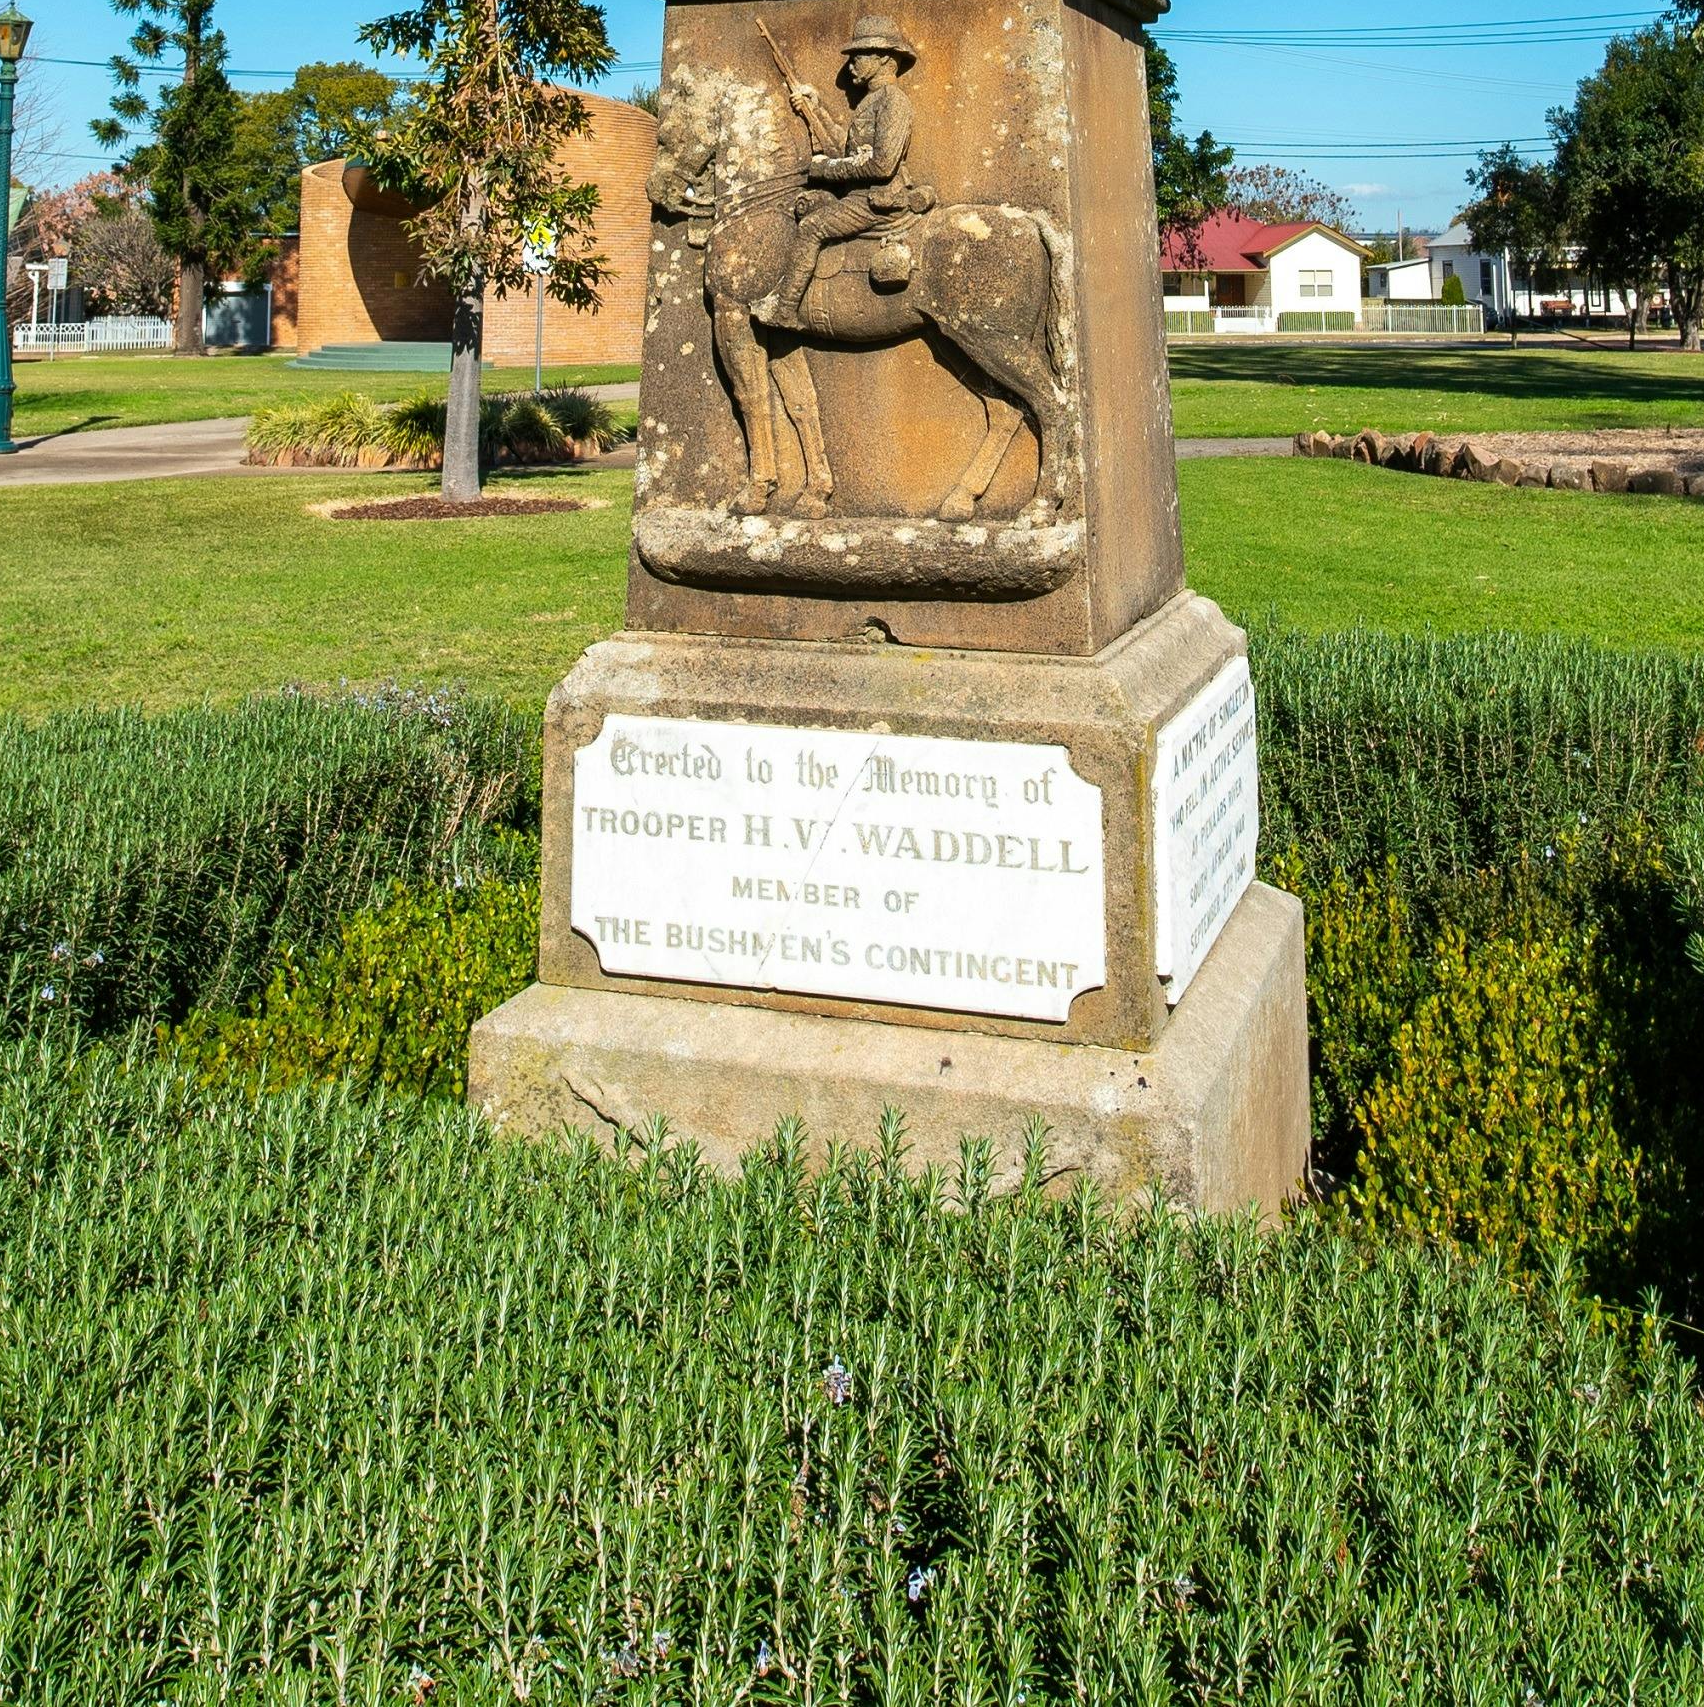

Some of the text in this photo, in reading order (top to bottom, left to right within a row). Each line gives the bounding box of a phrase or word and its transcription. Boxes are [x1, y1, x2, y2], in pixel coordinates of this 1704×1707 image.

[610, 730, 1057, 808] Erected to the Memory of
[1174, 754, 1180, 781] A
[1182, 723, 1207, 772] NATIVE
[1209, 712, 1217, 740] OF
[1186, 788, 1199, 820] FELL
[1200, 771, 1207, 801] IN
[1210, 742, 1231, 789] ACTIVE
[1232, 714, 1254, 759] SERVICE
[581, 806, 727, 843] TROOPER
[732, 876, 920, 913] MEMBER OF
[1190, 867, 1208, 908] SOUTH
[1212, 831, 1232, 877] AFRICAN
[594, 916, 1079, 990] THE BUSHMEN'S CONTINGENT
[1191, 893, 1220, 954] SEPTEMBER
